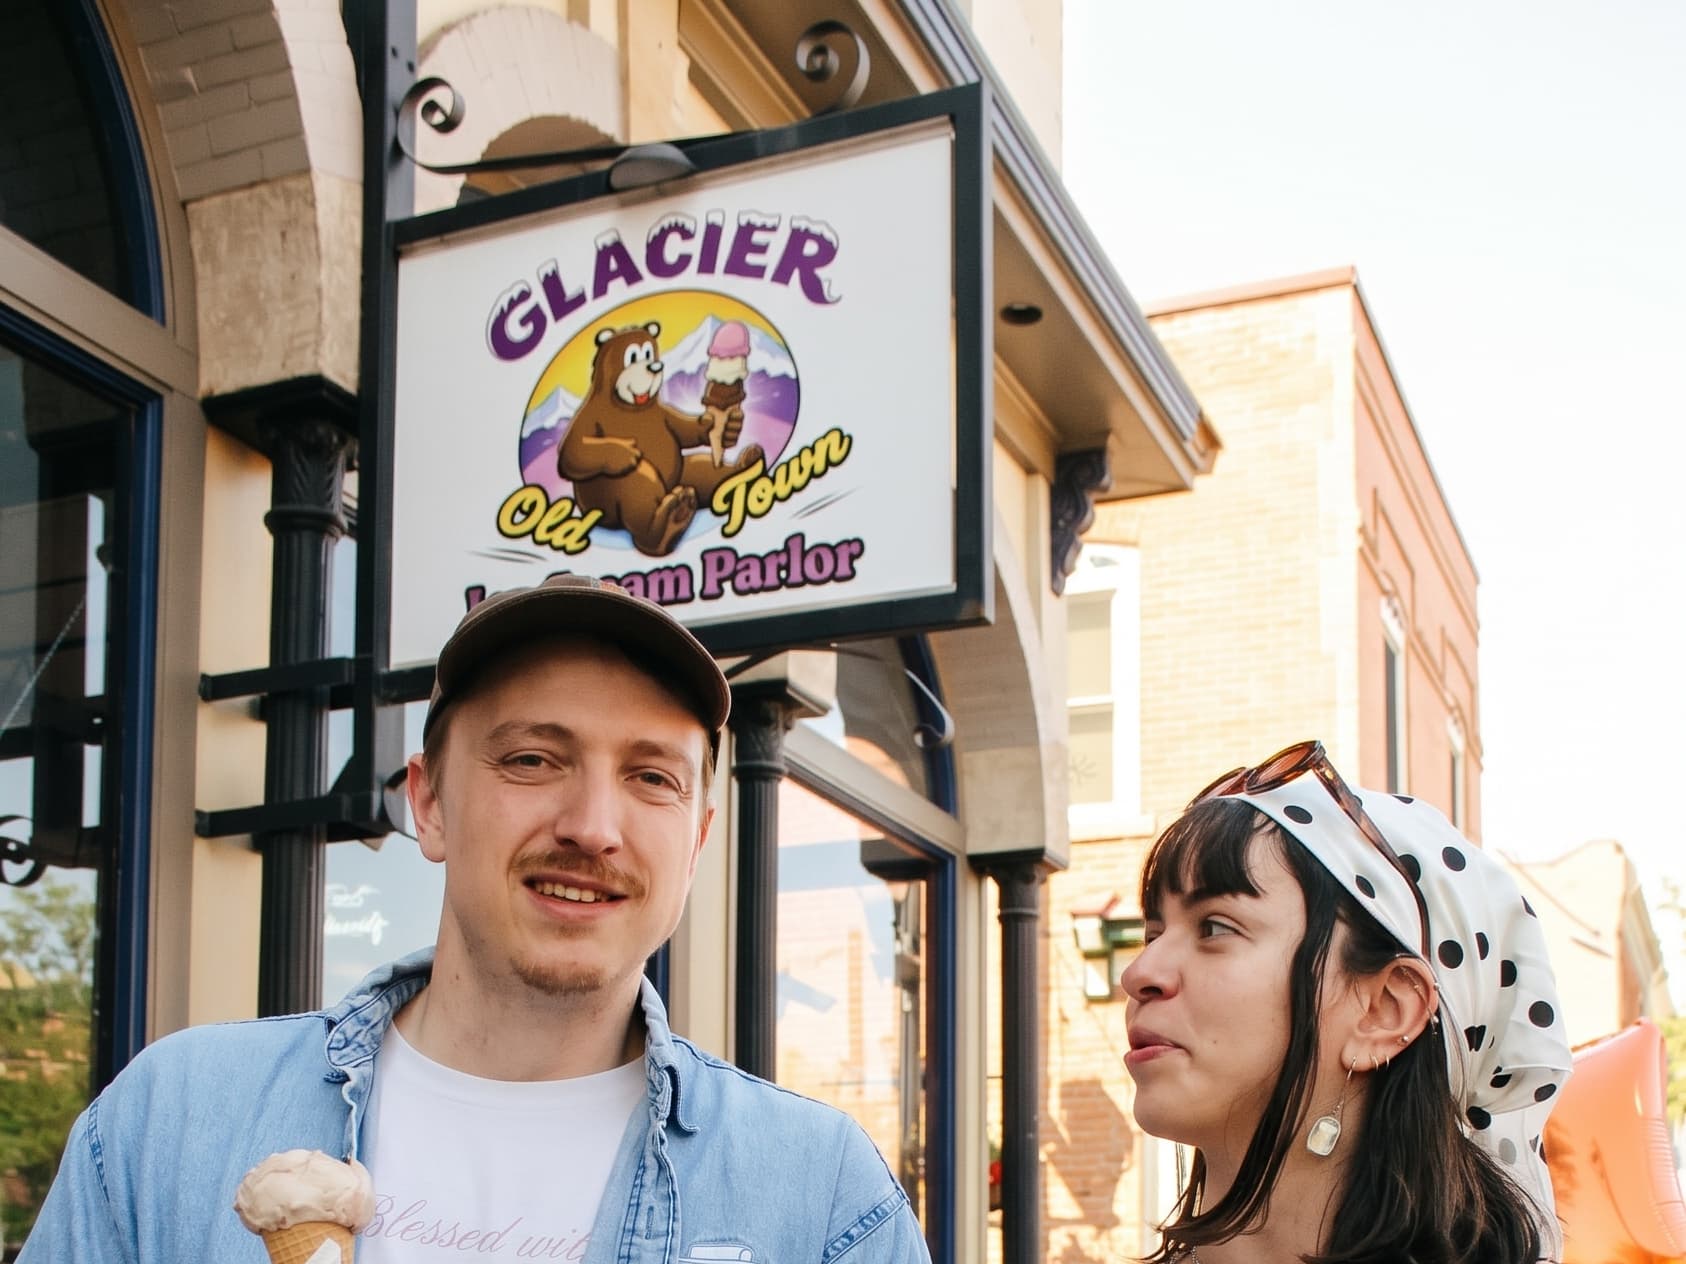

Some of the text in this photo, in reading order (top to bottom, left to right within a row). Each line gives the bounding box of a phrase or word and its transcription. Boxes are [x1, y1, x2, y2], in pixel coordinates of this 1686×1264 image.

[486, 209, 843, 362] GLACIER
[497, 426, 853, 554] Old Town
[701, 533, 864, 599] Parlor
[363, 1194, 524, 1253] Blessed
